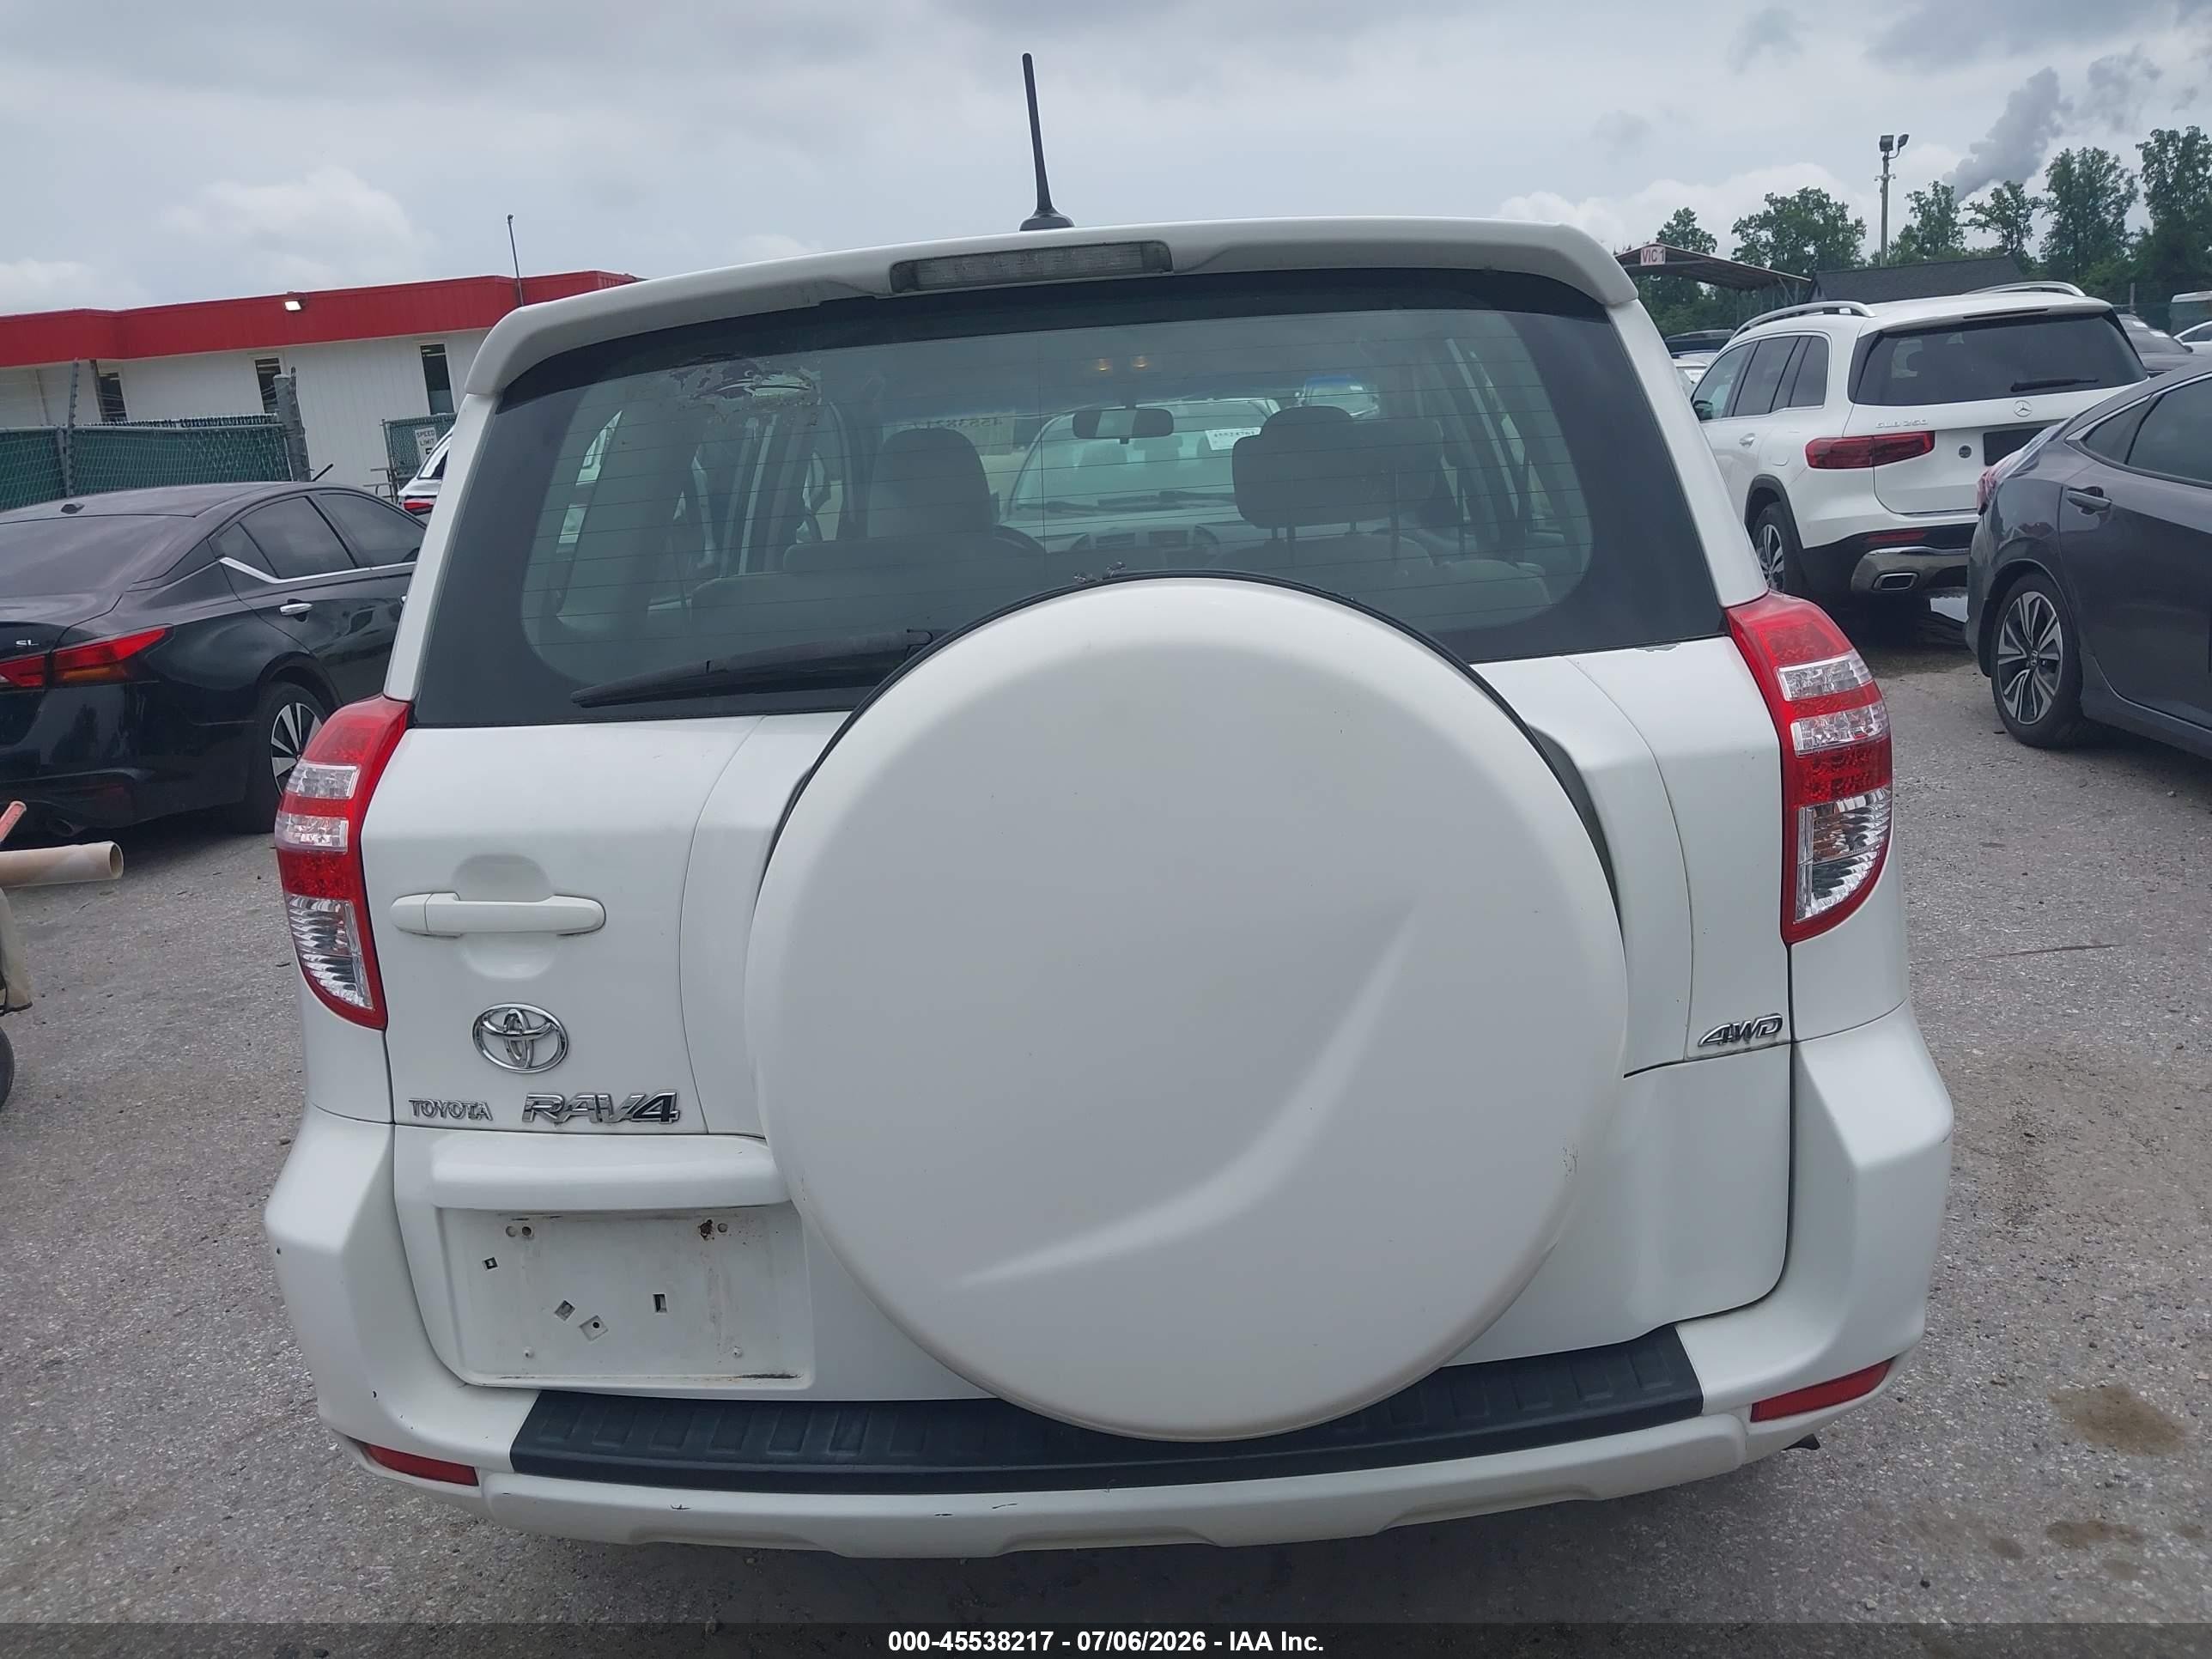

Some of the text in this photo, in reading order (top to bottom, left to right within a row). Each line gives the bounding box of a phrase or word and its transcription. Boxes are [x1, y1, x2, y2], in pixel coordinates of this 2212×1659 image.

[1642, 249, 1665, 263] VIC 1
[420, 438, 435, 447] LIMIT
[1698, 1013, 1784, 1047] 4WD
[408, 1091, 681, 1126] TOYOTA RAV4
